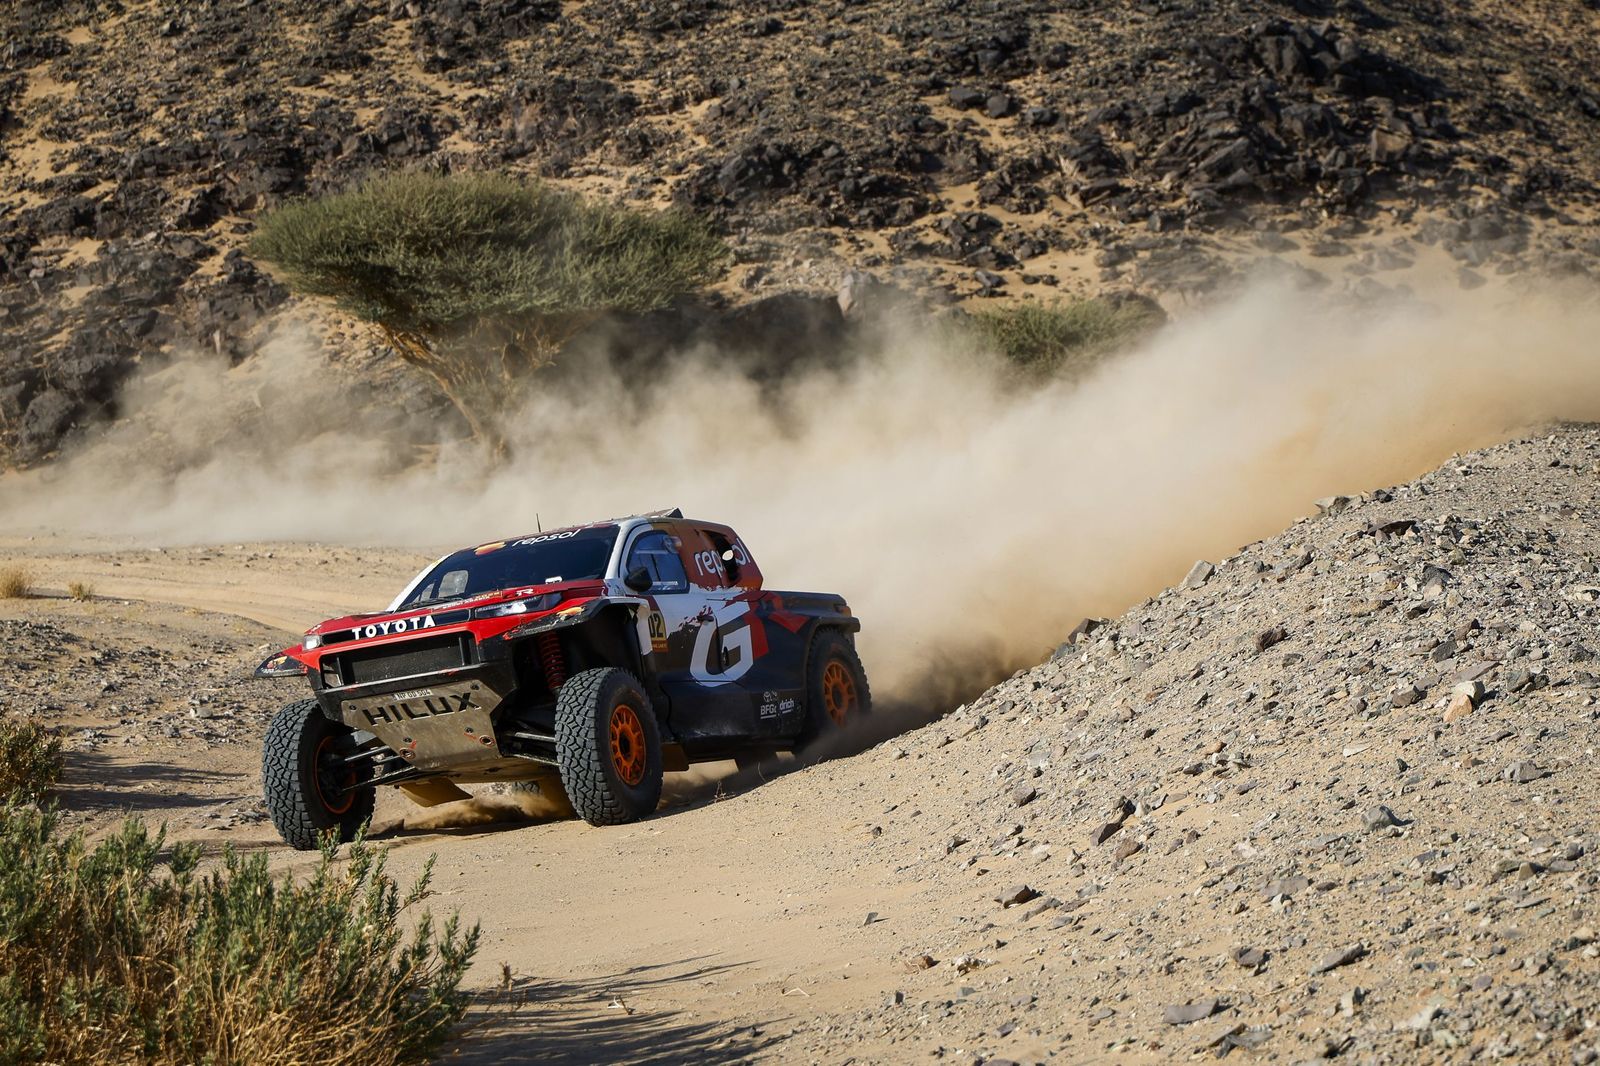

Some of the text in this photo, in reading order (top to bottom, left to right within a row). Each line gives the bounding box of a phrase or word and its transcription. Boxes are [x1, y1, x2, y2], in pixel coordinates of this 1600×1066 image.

[512, 528, 582, 547] repsol
[694, 537, 751, 578] repol
[352, 615, 436, 640] TOYOTA
[362, 692, 481, 726] HILUX
[760, 698, 795, 715] BFGdrich
